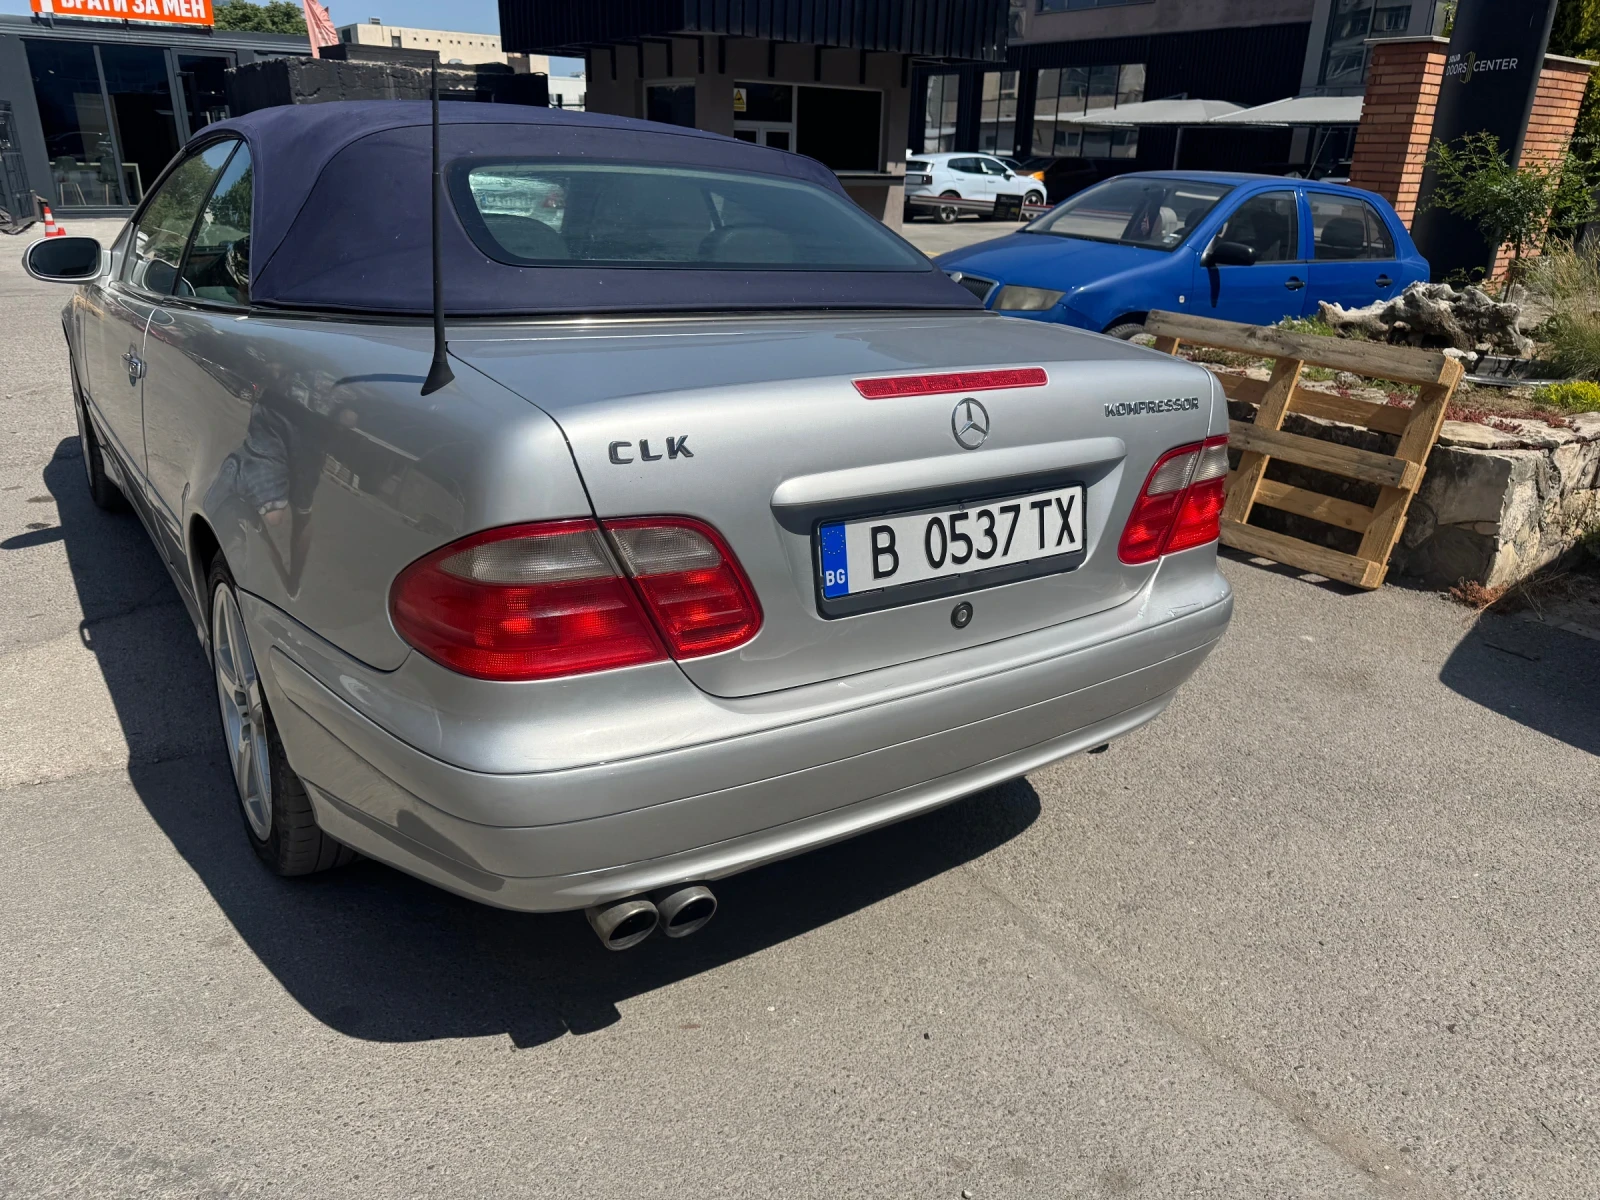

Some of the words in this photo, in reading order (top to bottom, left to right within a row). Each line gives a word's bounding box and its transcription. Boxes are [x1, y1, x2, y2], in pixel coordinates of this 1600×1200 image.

[161, 0, 206, 18] МЕН
[1445, 62, 1468, 76] DOORS
[1473, 57, 1519, 72] CENTER
[1103, 396, 1200, 418] KOMPRESSOR
[608, 434, 695, 465] CLK
[869, 524, 900, 580] B
[924, 503, 1022, 570] 0537
[1030, 494, 1077, 551] TX
[824, 568, 847, 587] BG
